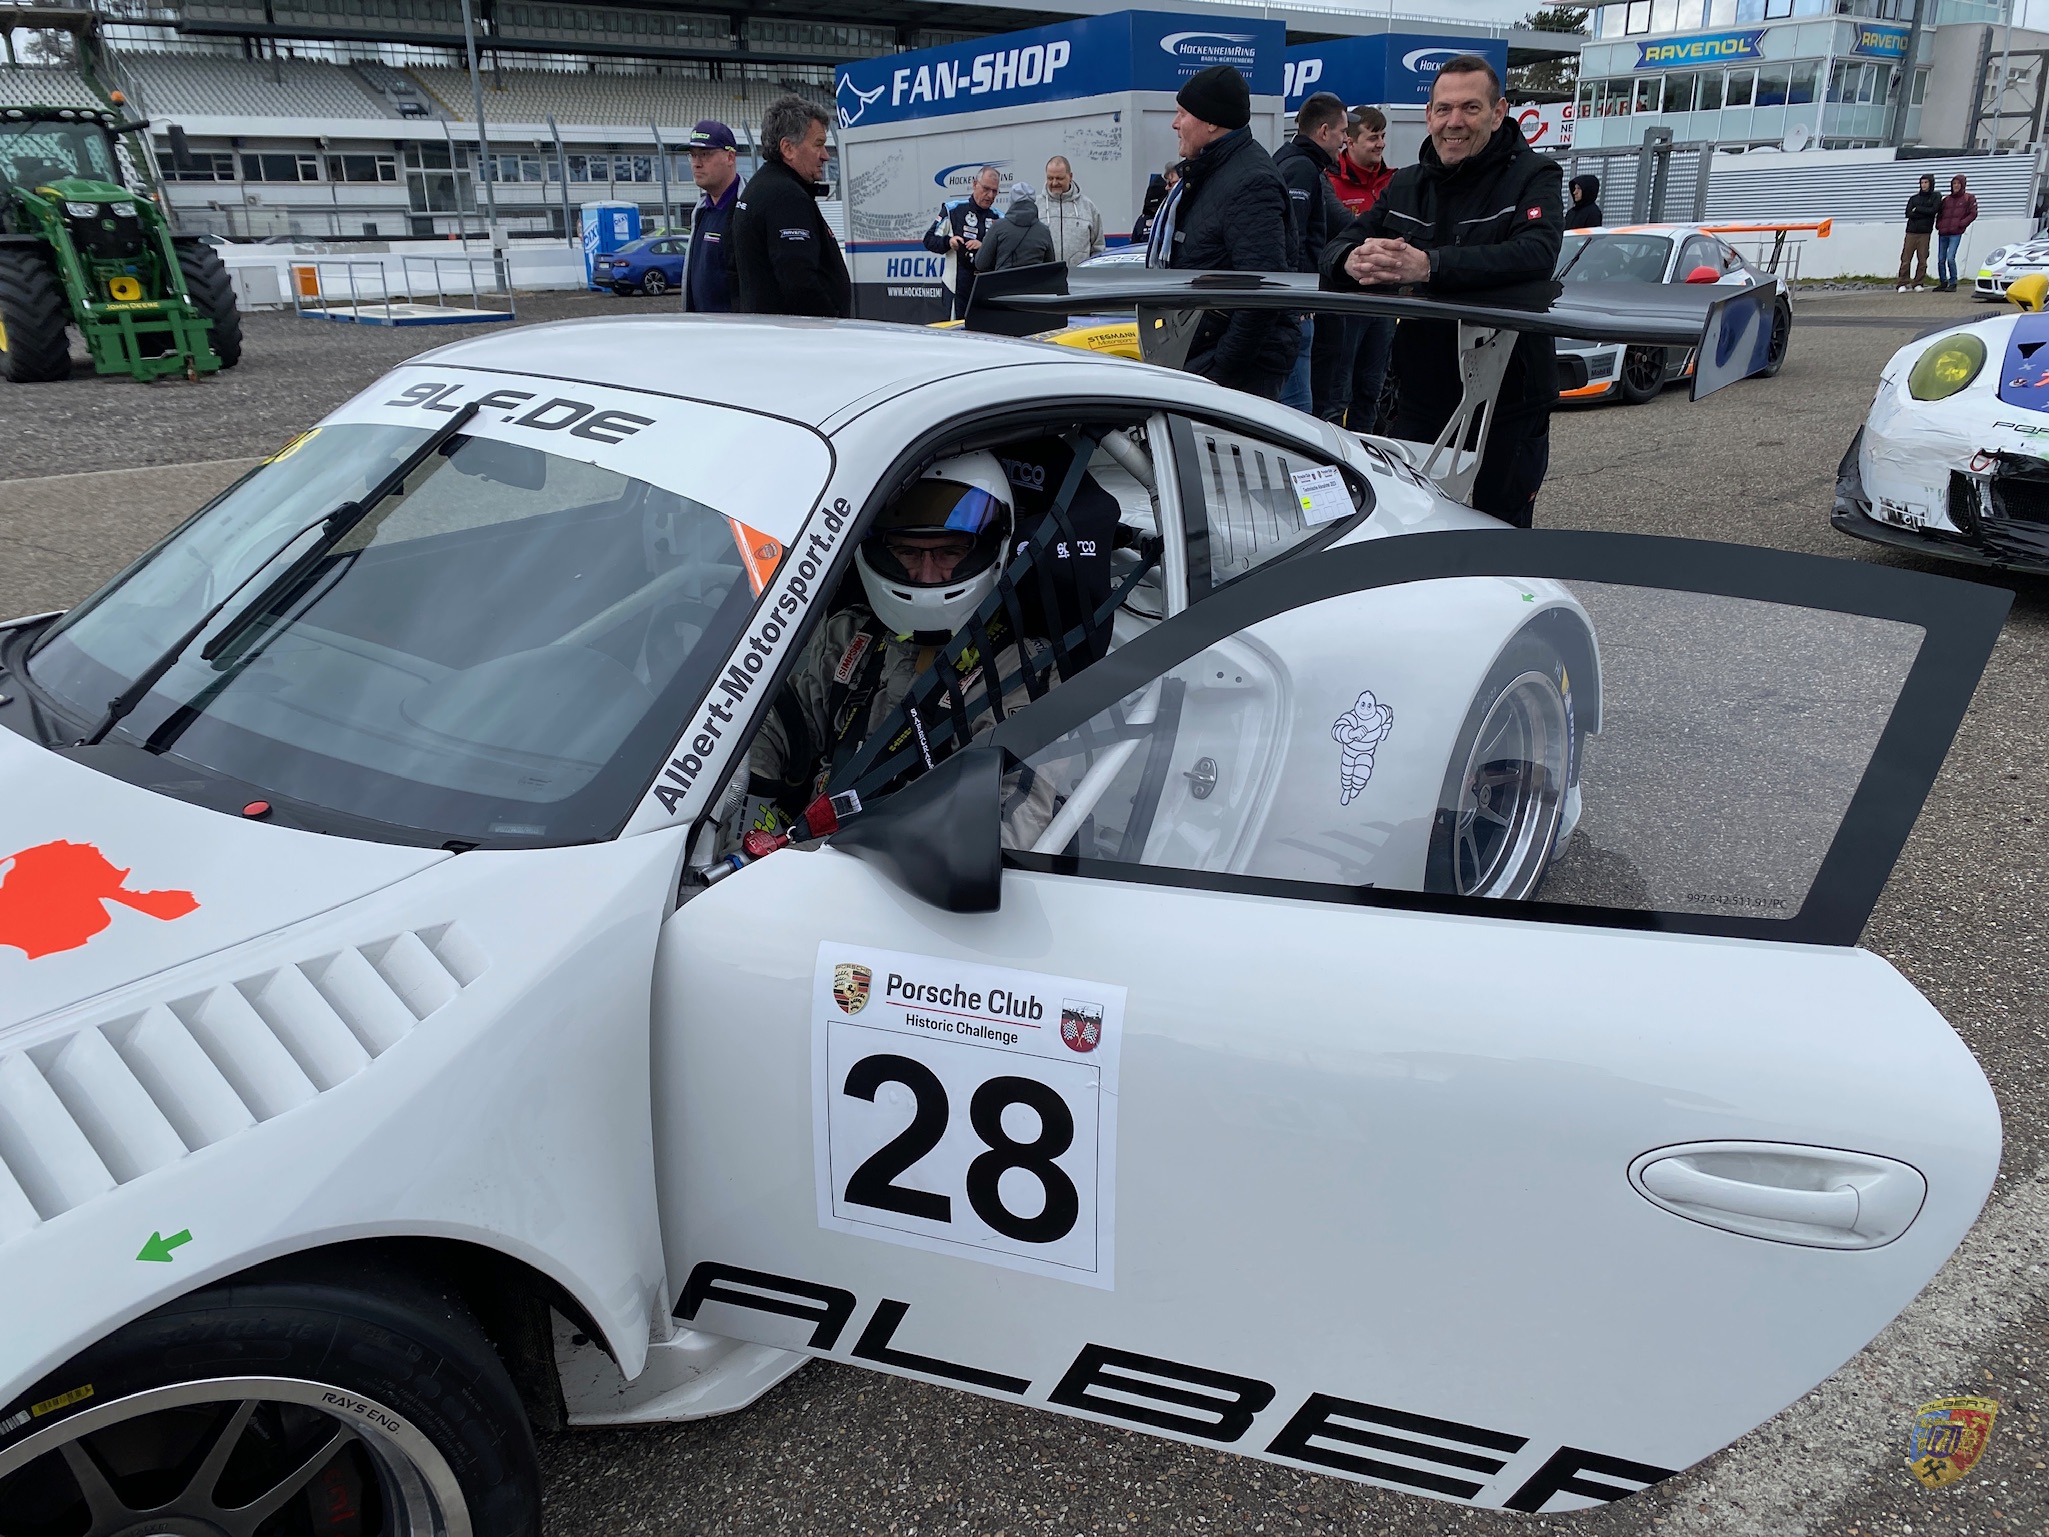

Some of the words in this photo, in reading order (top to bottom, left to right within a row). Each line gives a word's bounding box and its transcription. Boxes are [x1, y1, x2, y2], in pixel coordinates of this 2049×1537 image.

[1645, 37, 1750, 62] RAVENOL
[1861, 31, 1908, 50] RAVENO
[891, 39, 1071, 107] FAN-SHOP
[1419, 59, 1443, 71] HOCK
[887, 257, 945, 278] HOCK
[887, 287, 943, 298] WWW.HOCKENHEIM
[1088, 332, 1136, 343] STEGMANN
[383, 382, 657, 445] 9LF.DE
[653, 497, 851, 816] Albert-Motorsport.de
[838, 634, 865, 677] SIMPSON
[886, 973, 981, 1011] Porsche
[988, 989, 1043, 1021] Club
[906, 1013, 954, 1033] Historic
[956, 1022, 1018, 1045] Challenge
[843, 1053, 1080, 1244] 28
[321, 1392, 367, 1414] RAYS
[366, 1409, 400, 1435] ENG.
